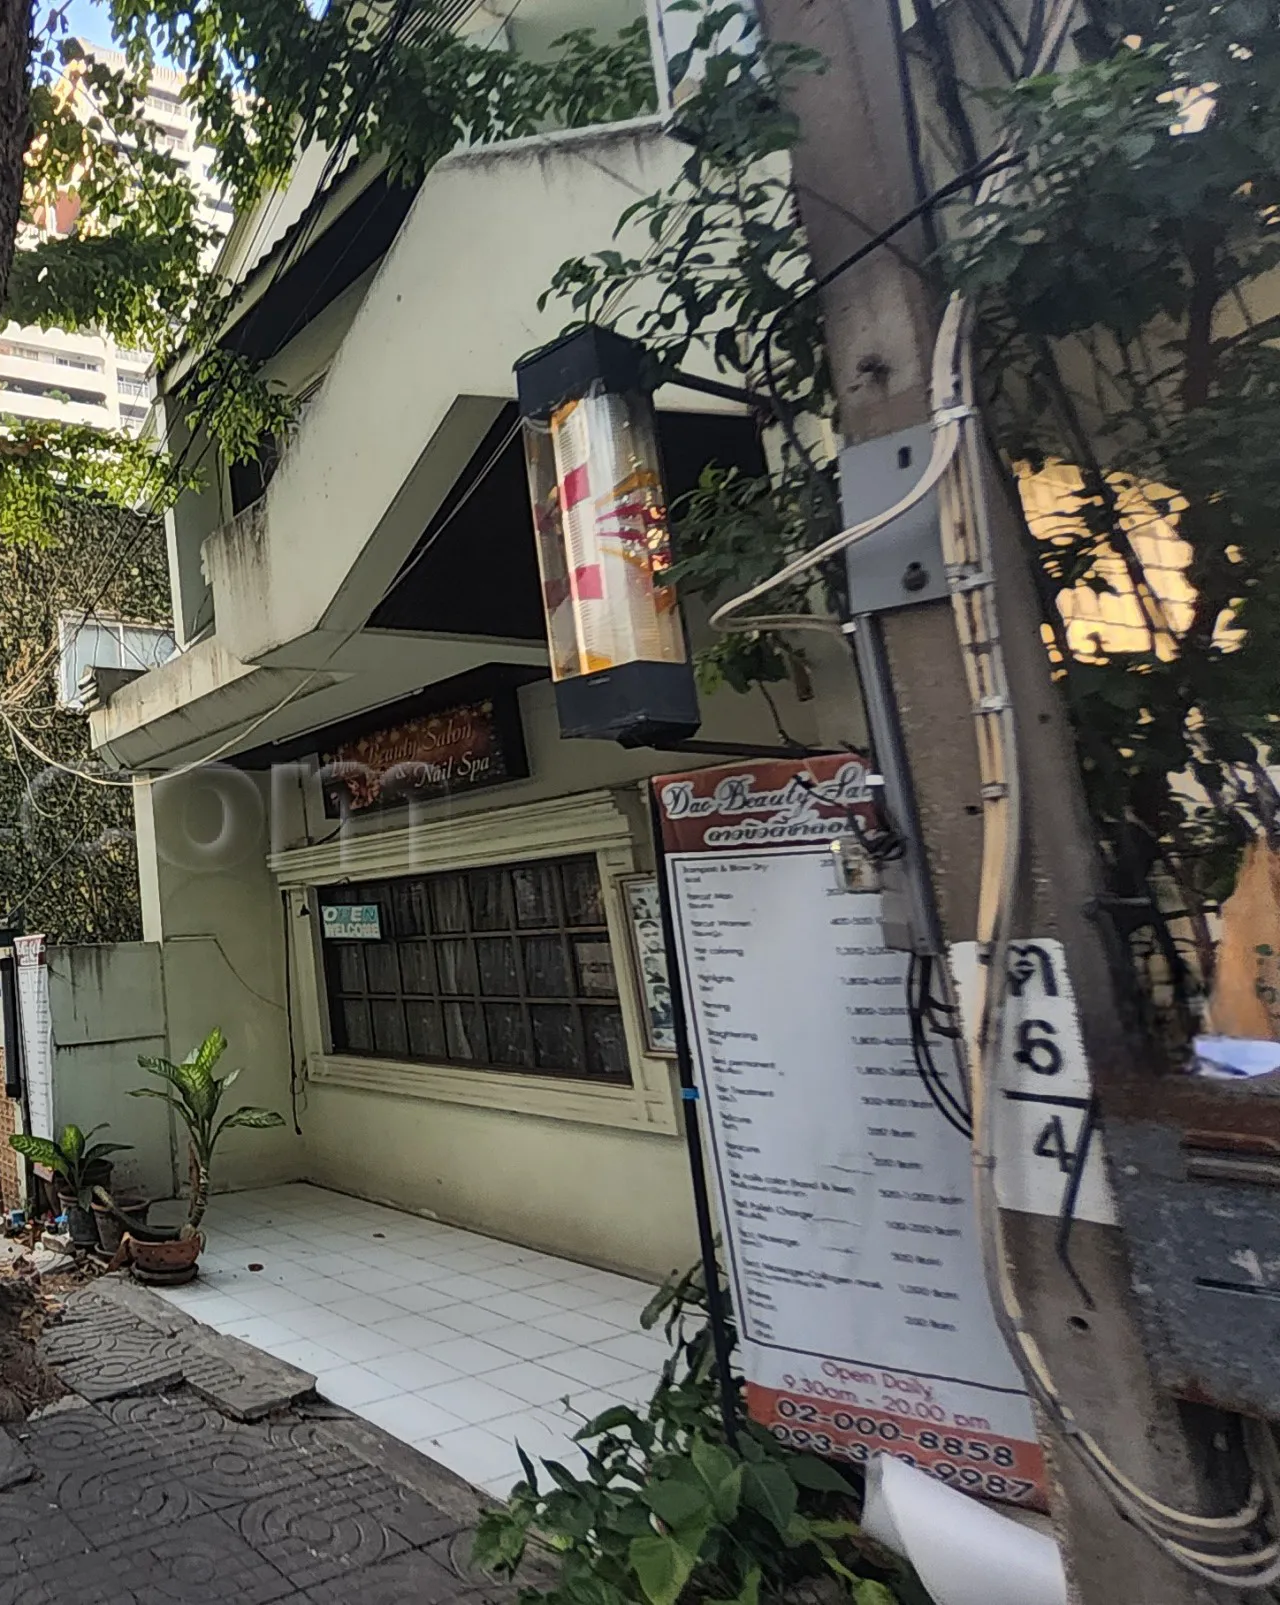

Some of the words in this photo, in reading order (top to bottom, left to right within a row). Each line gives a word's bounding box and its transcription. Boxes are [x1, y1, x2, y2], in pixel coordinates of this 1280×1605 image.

[367, 737, 418, 765] Beauty
[423, 719, 473, 751] Salon
[395, 767, 406, 780] &
[414, 756, 452, 787] Nail
[457, 751, 490, 782] Spa
[665, 784, 713, 816] Dao
[721, 777, 812, 820] Beauty
[323, 906, 377, 922] OPEN
[1014, 1018, 1063, 1076] 6
[1033, 1115, 1076, 1173] 4
[781, 1373, 859, 1405] 9.30am
[881, 1394, 946, 1422] 20.00
[821, 1361, 877, 1386] Open
[883, 1373, 935, 1401] Daily
[777, 1398, 1015, 1467] 02-000-8858
[769, 1423, 1036, 1501] 093-3-9987
